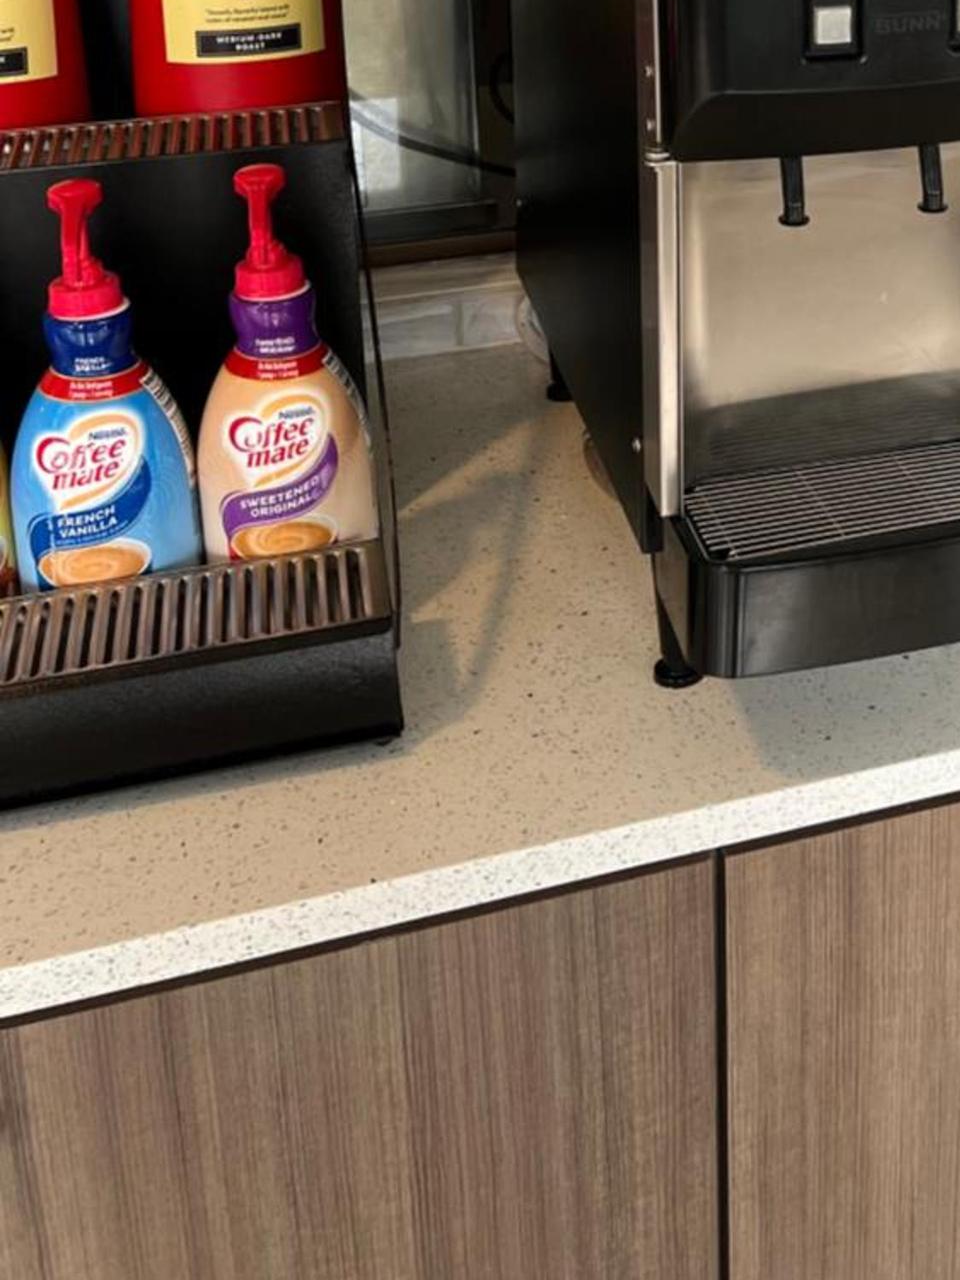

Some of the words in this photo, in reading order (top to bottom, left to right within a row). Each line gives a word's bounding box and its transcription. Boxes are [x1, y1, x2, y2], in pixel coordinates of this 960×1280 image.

[228, 416, 315, 454] Coffee
[36, 437, 127, 474] Coffee
[247, 438, 311, 469] mate
[52, 462, 122, 491] mate
[240, 476, 321, 509] SWEETENED
[250, 493, 313, 518] ORIGINAL
[57, 505, 116, 529] FRENCH
[58, 517, 119, 539] VANILLA
